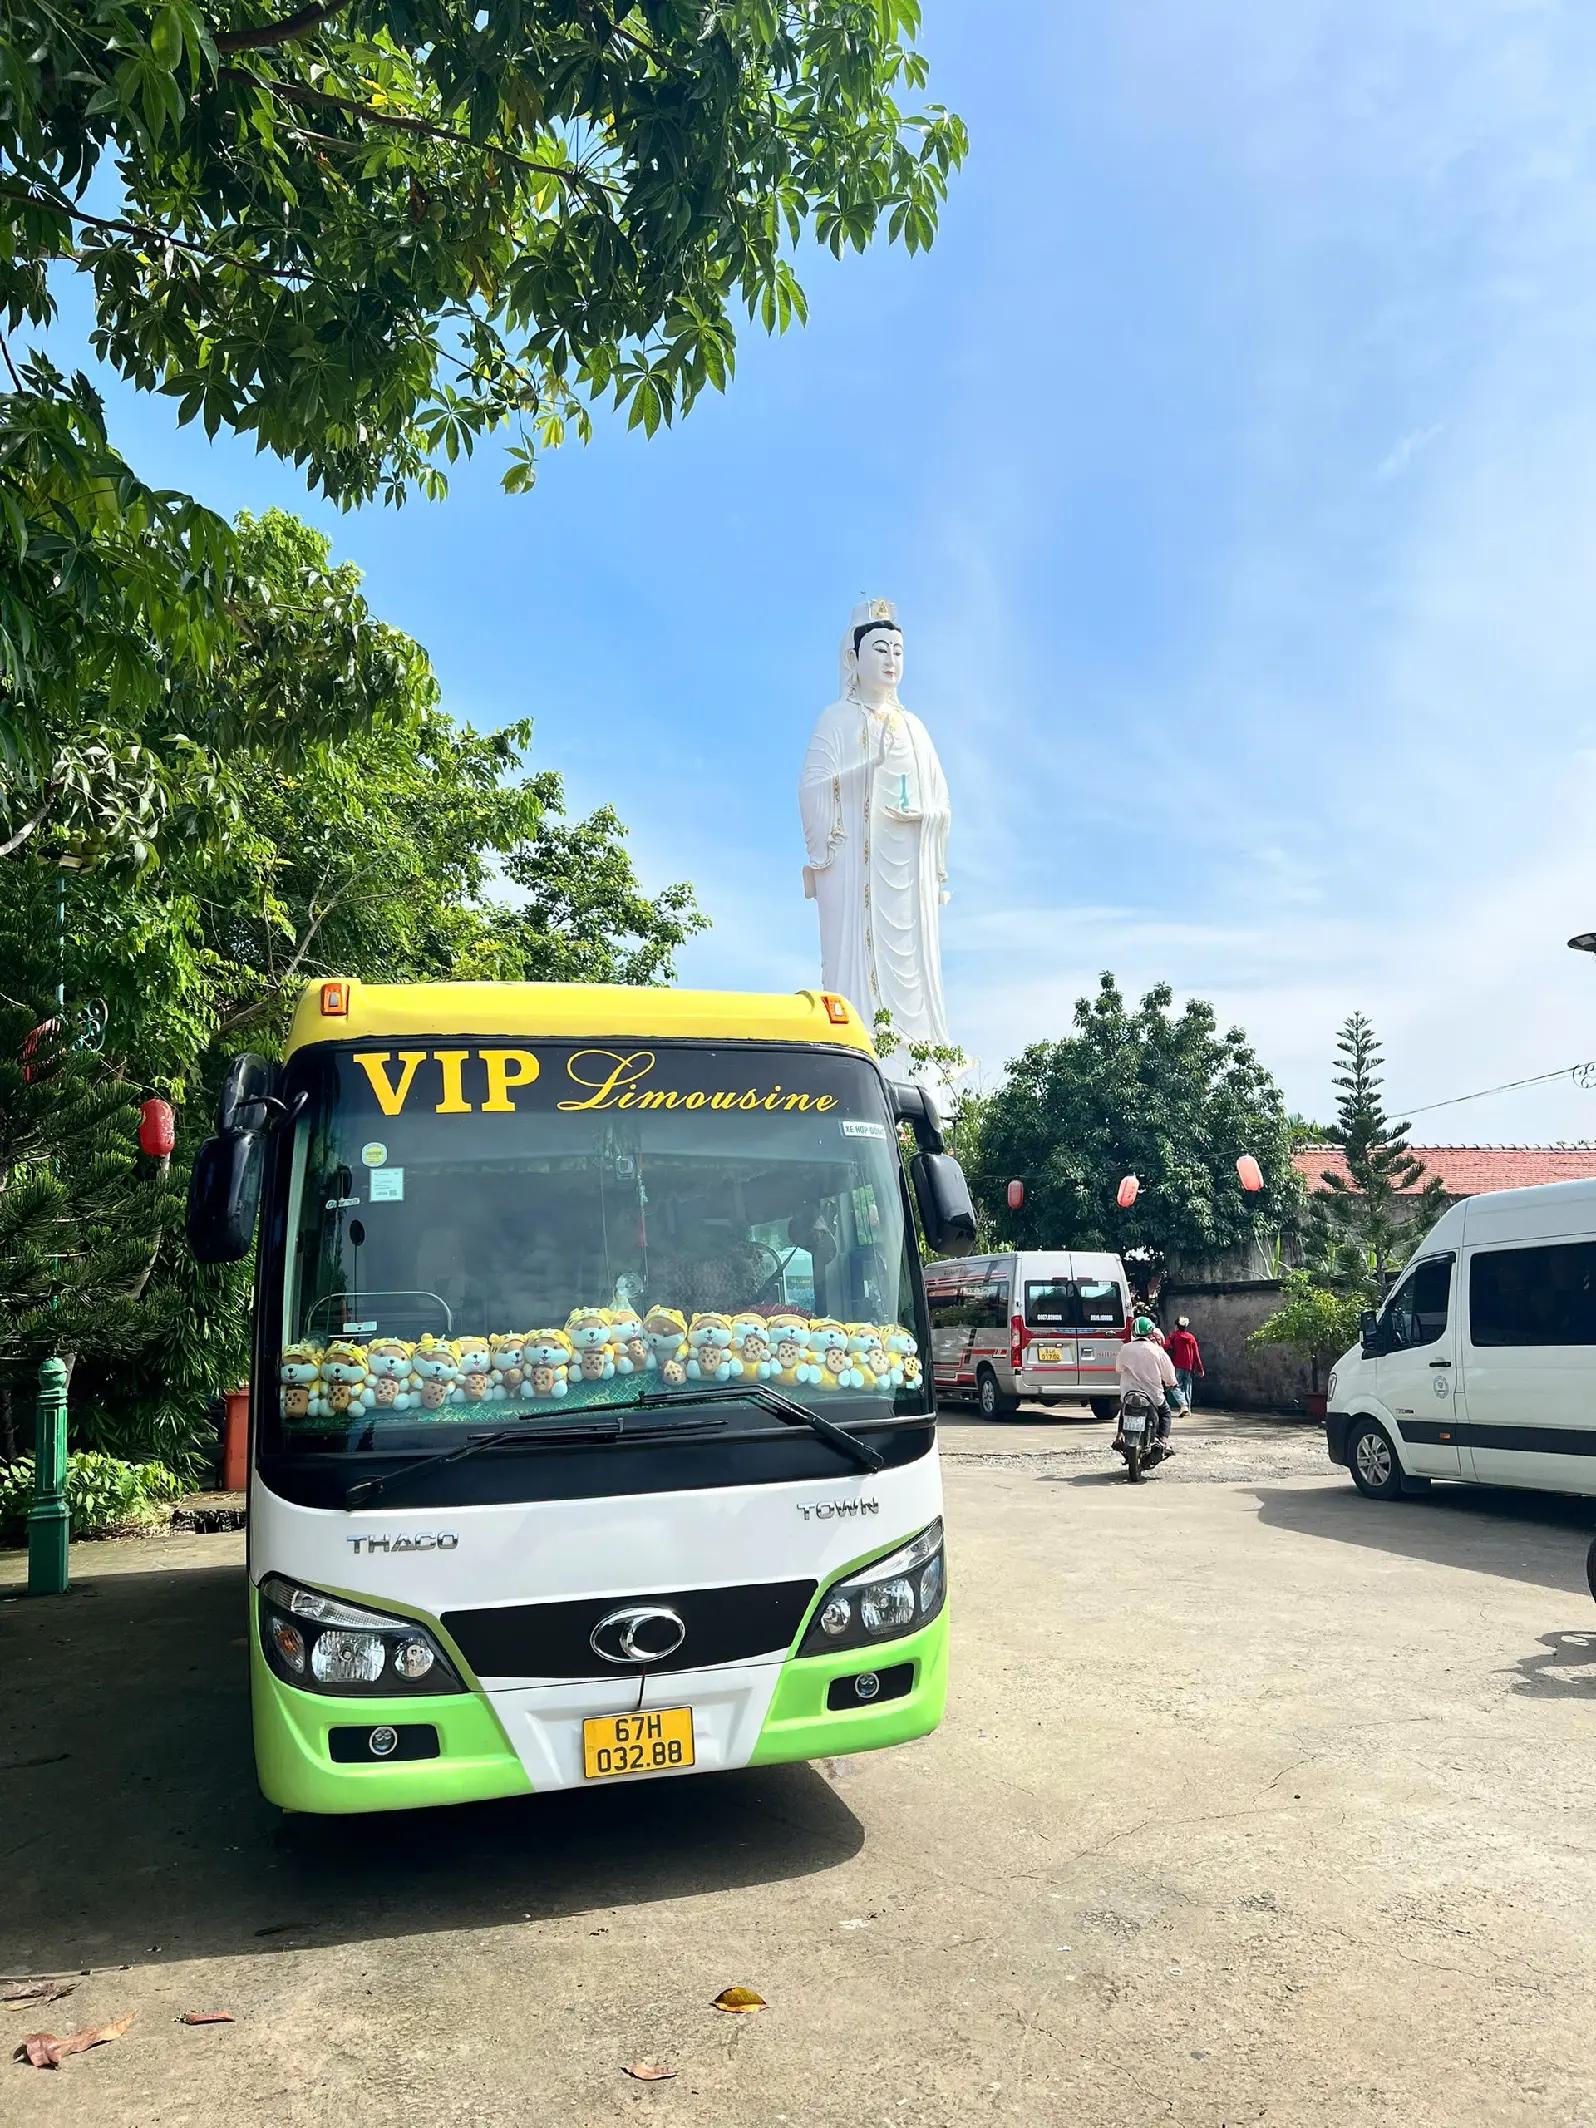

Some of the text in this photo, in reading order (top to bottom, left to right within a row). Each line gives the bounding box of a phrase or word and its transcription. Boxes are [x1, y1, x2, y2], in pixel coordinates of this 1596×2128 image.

[353, 1049, 839, 1116] VIP Limousine
[796, 1496, 879, 1520] TOWN
[346, 1532, 459, 1554] THACO
[615, 1714, 662, 1742] 67H
[597, 1740, 683, 1773] 032.88
